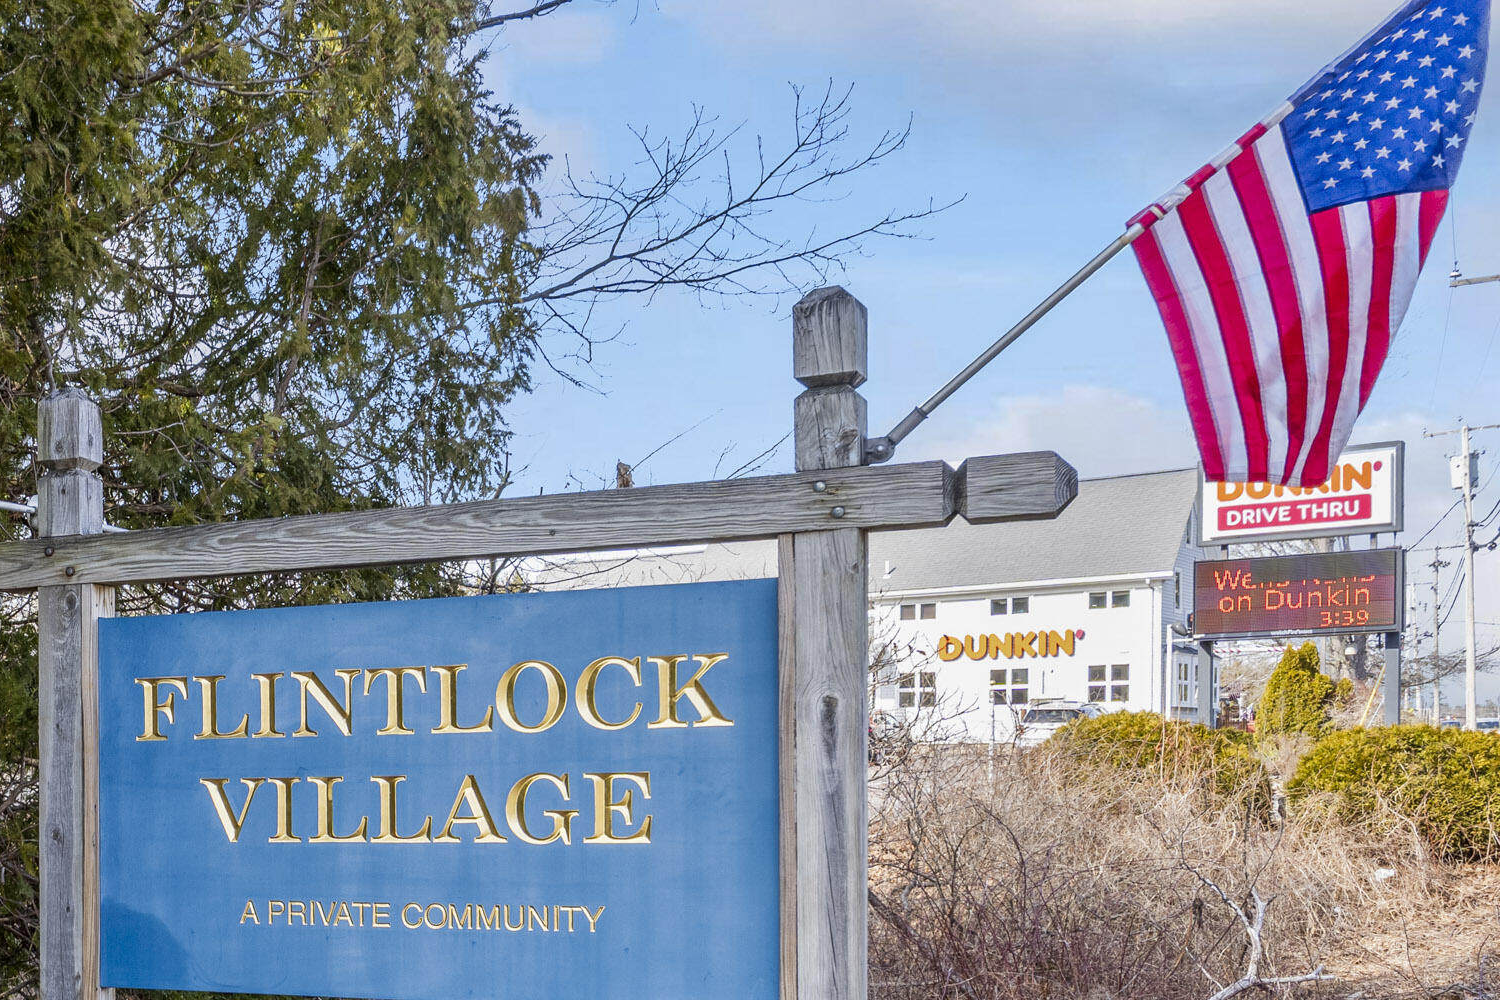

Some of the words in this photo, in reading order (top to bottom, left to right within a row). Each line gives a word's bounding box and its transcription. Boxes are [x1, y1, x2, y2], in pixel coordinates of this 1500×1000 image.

[1226, 505, 1291, 526] DRIVE
[1296, 500, 1360, 519] THRU
[1219, 595, 1251, 613] on
[1265, 584, 1370, 611] Dunkin
[1320, 609, 1369, 627] 3:39
[938, 628, 1086, 661] DUNKIN'
[134, 652, 735, 742] FLINTLOCK
[199, 771, 653, 846] VILLAGE
[239, 900, 261, 925] A
[268, 900, 391, 928] PRIVATE
[401, 902, 606, 933] COMMUNITY
